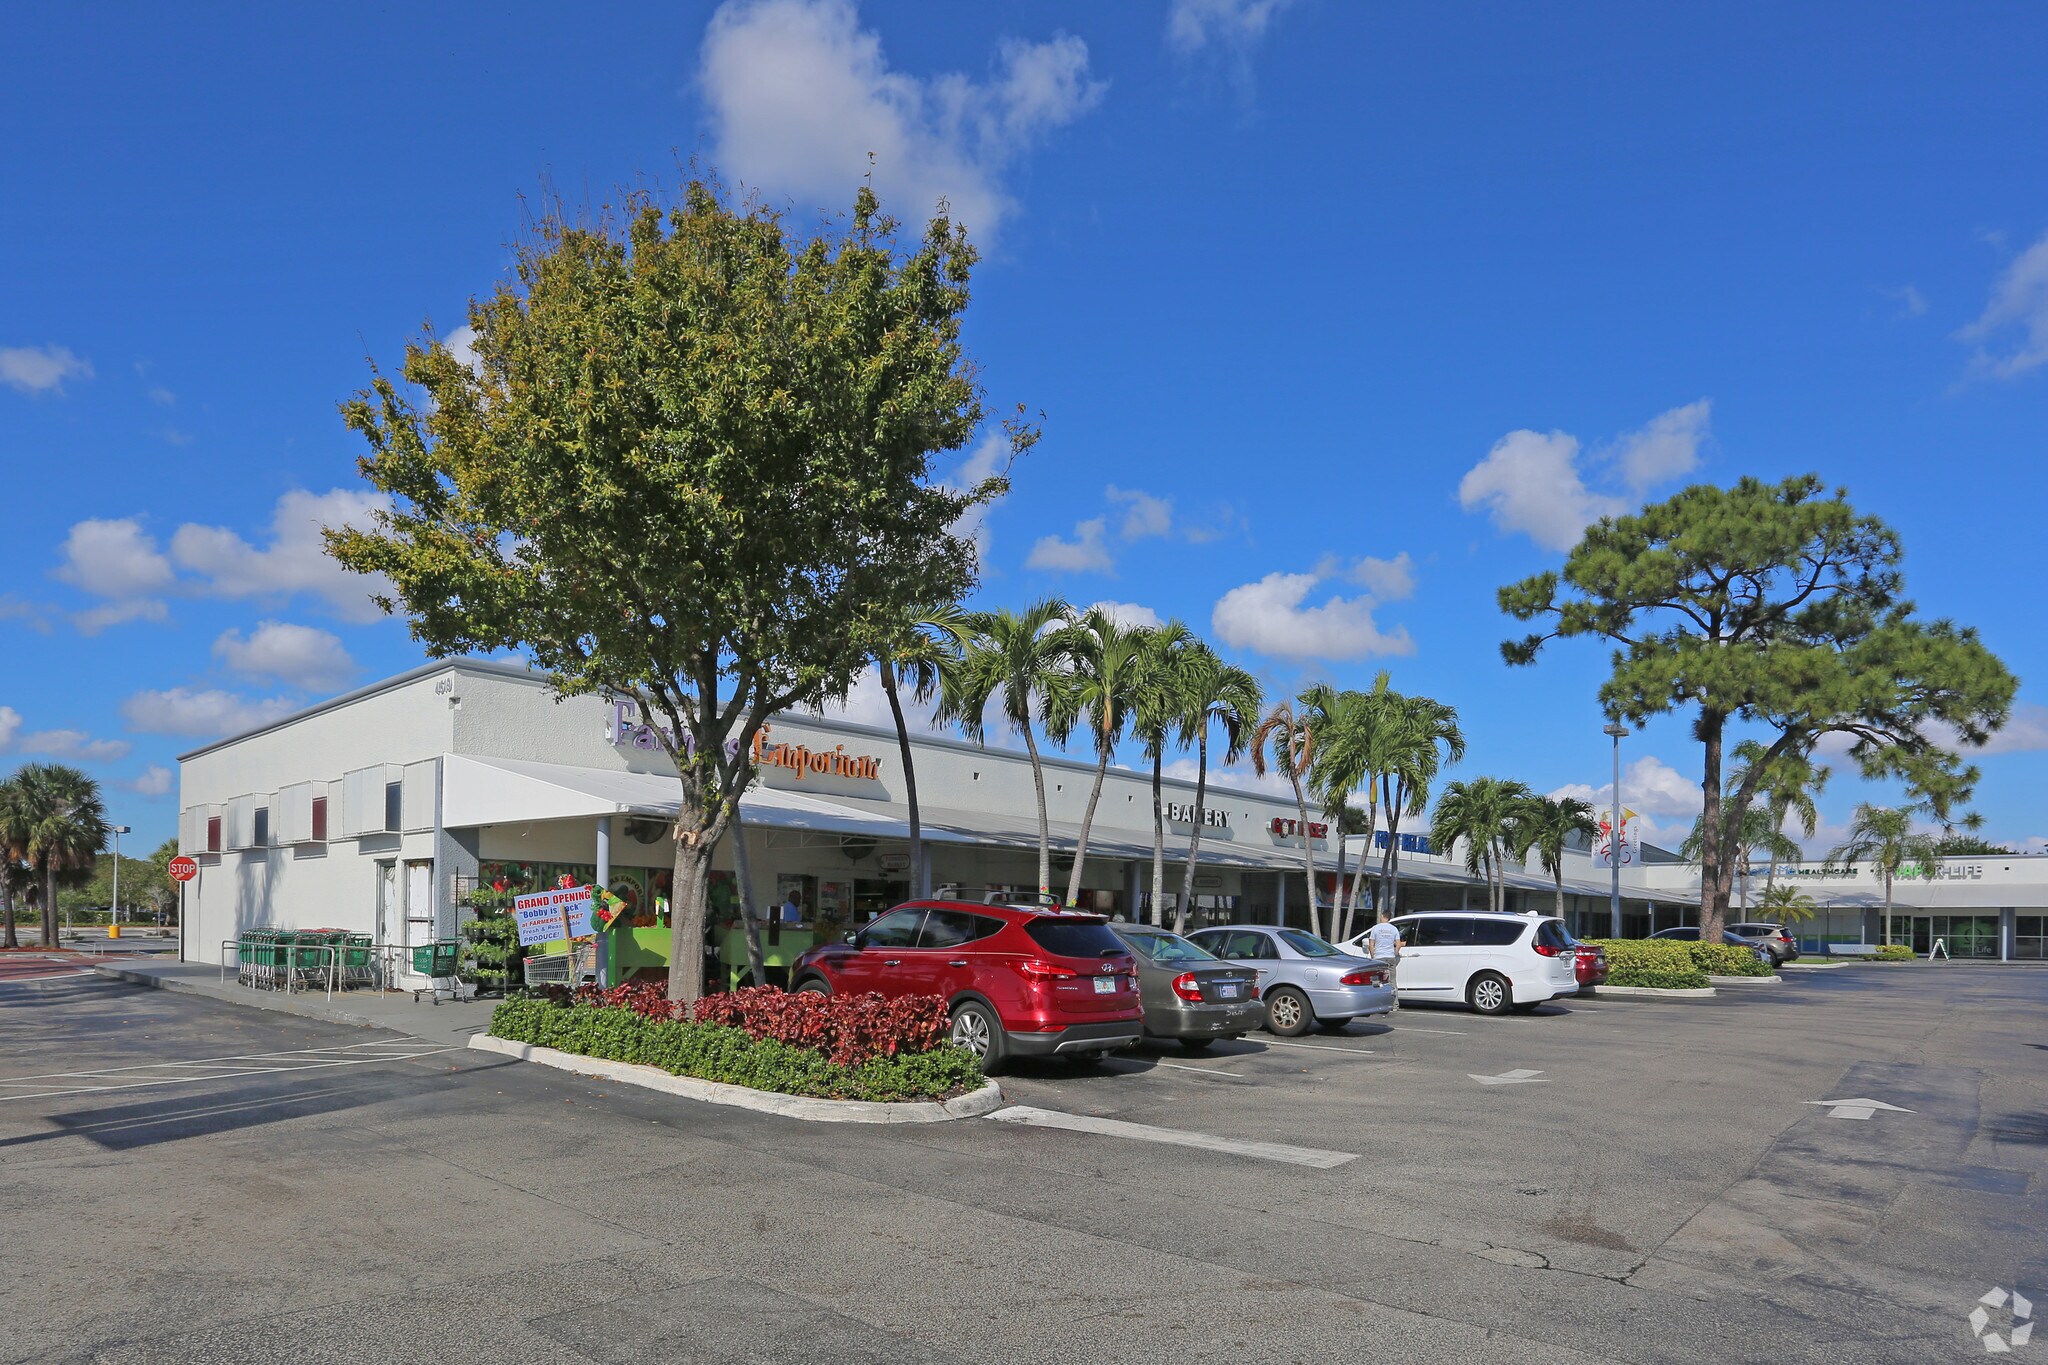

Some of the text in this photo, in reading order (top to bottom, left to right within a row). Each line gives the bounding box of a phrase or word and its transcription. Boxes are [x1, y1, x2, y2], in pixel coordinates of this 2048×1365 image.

[752, 722, 879, 780] Emporium
[1170, 802, 1232, 828] BAERY
[171, 864, 195, 873] STOP
[517, 890, 591, 910] GRAND OPENING
[550, 907, 558, 915] is
[529, 917, 558, 926] FARMERS
[559, 913, 584, 921] MRKET
[522, 926, 540, 935] Fresh
[548, 921, 581, 930] Reasable
[523, 932, 560, 943] PRODUCE!
